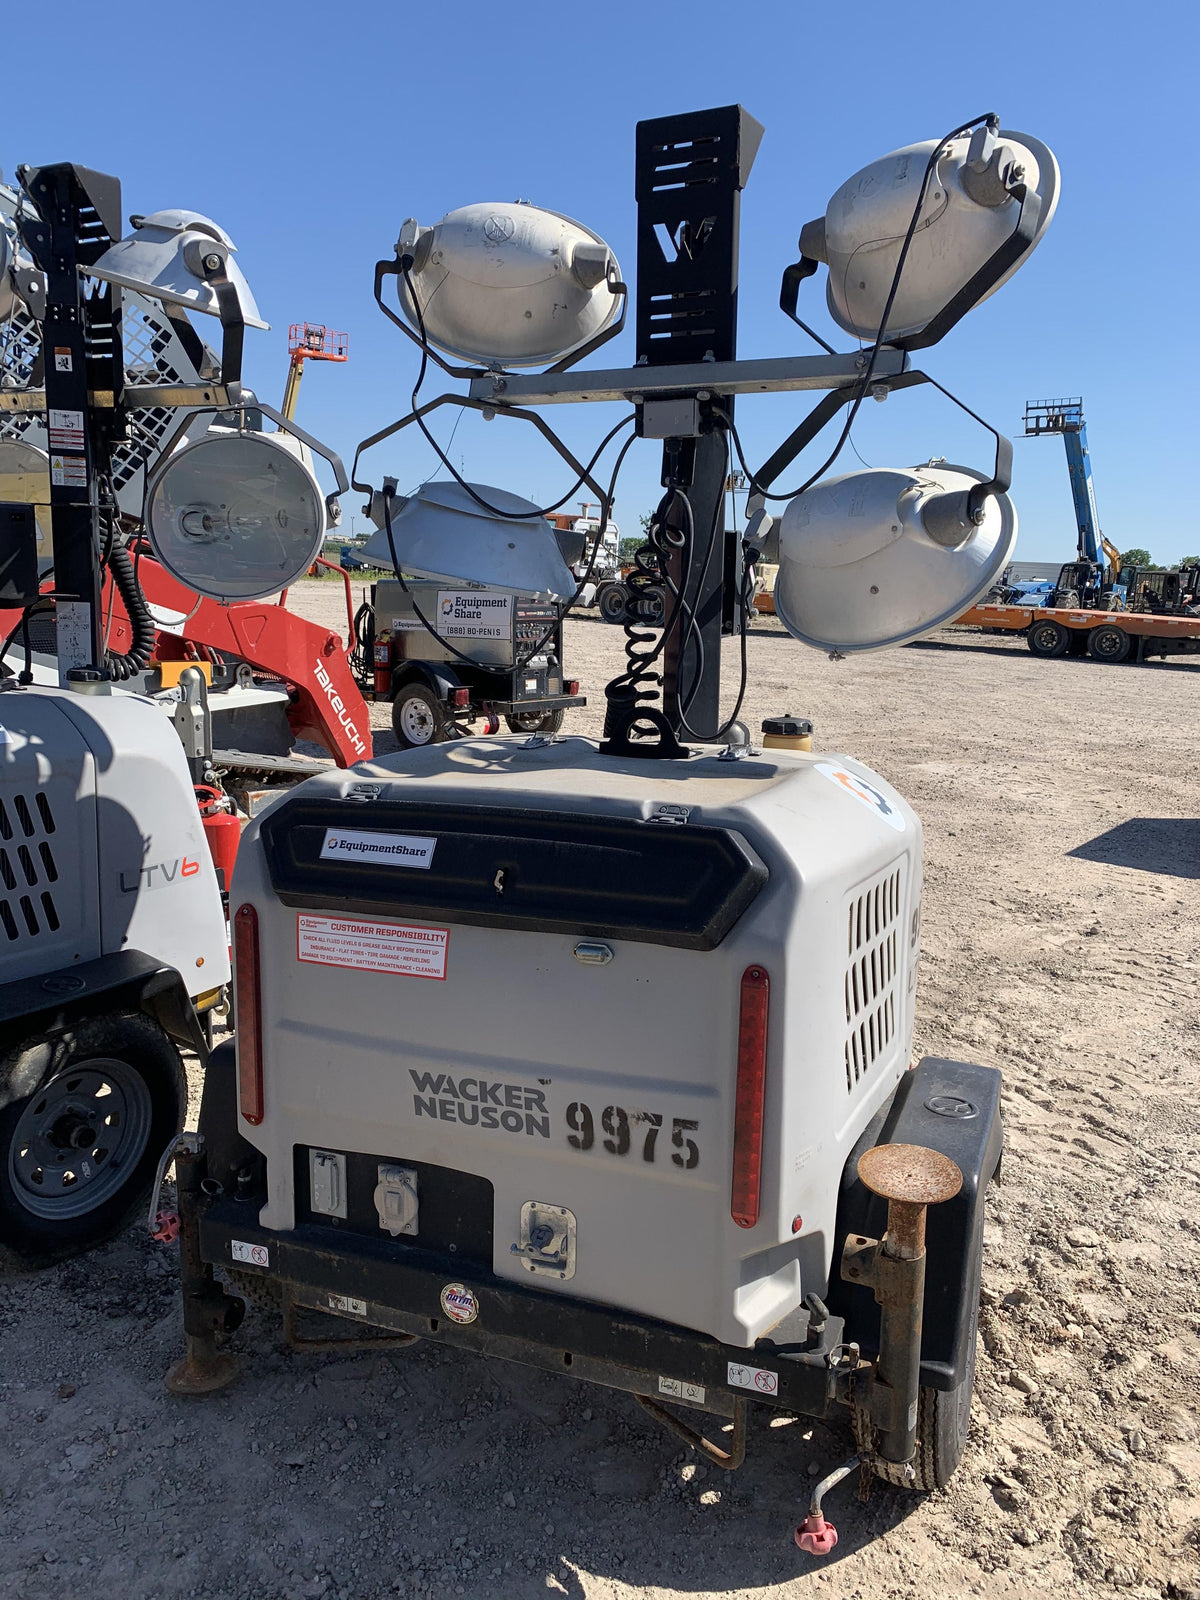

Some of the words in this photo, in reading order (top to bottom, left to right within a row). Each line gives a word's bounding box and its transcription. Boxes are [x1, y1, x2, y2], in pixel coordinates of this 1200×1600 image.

[455, 597, 507, 609] Equipment
[454, 608, 482, 619] Share
[447, 626, 465, 635] (888)
[314, 658, 366, 755] TAKEUCHI
[339, 839, 427, 857] EquipmentShare
[120, 857, 199, 893] LTV6
[331, 923, 374, 934] CUSTOMER
[375, 928, 445, 942] RESPONSIBILITY
[310, 944, 335, 952] INSURANCE
[402, 956, 430, 964] REFUELING
[377, 961, 411, 970] MAINTENANCE
[415, 966, 440, 974] CLEANING
[408, 1068, 550, 1114] WACKER
[413, 1094, 551, 1139] NEUSON
[565, 1101, 700, 1170] 9975
